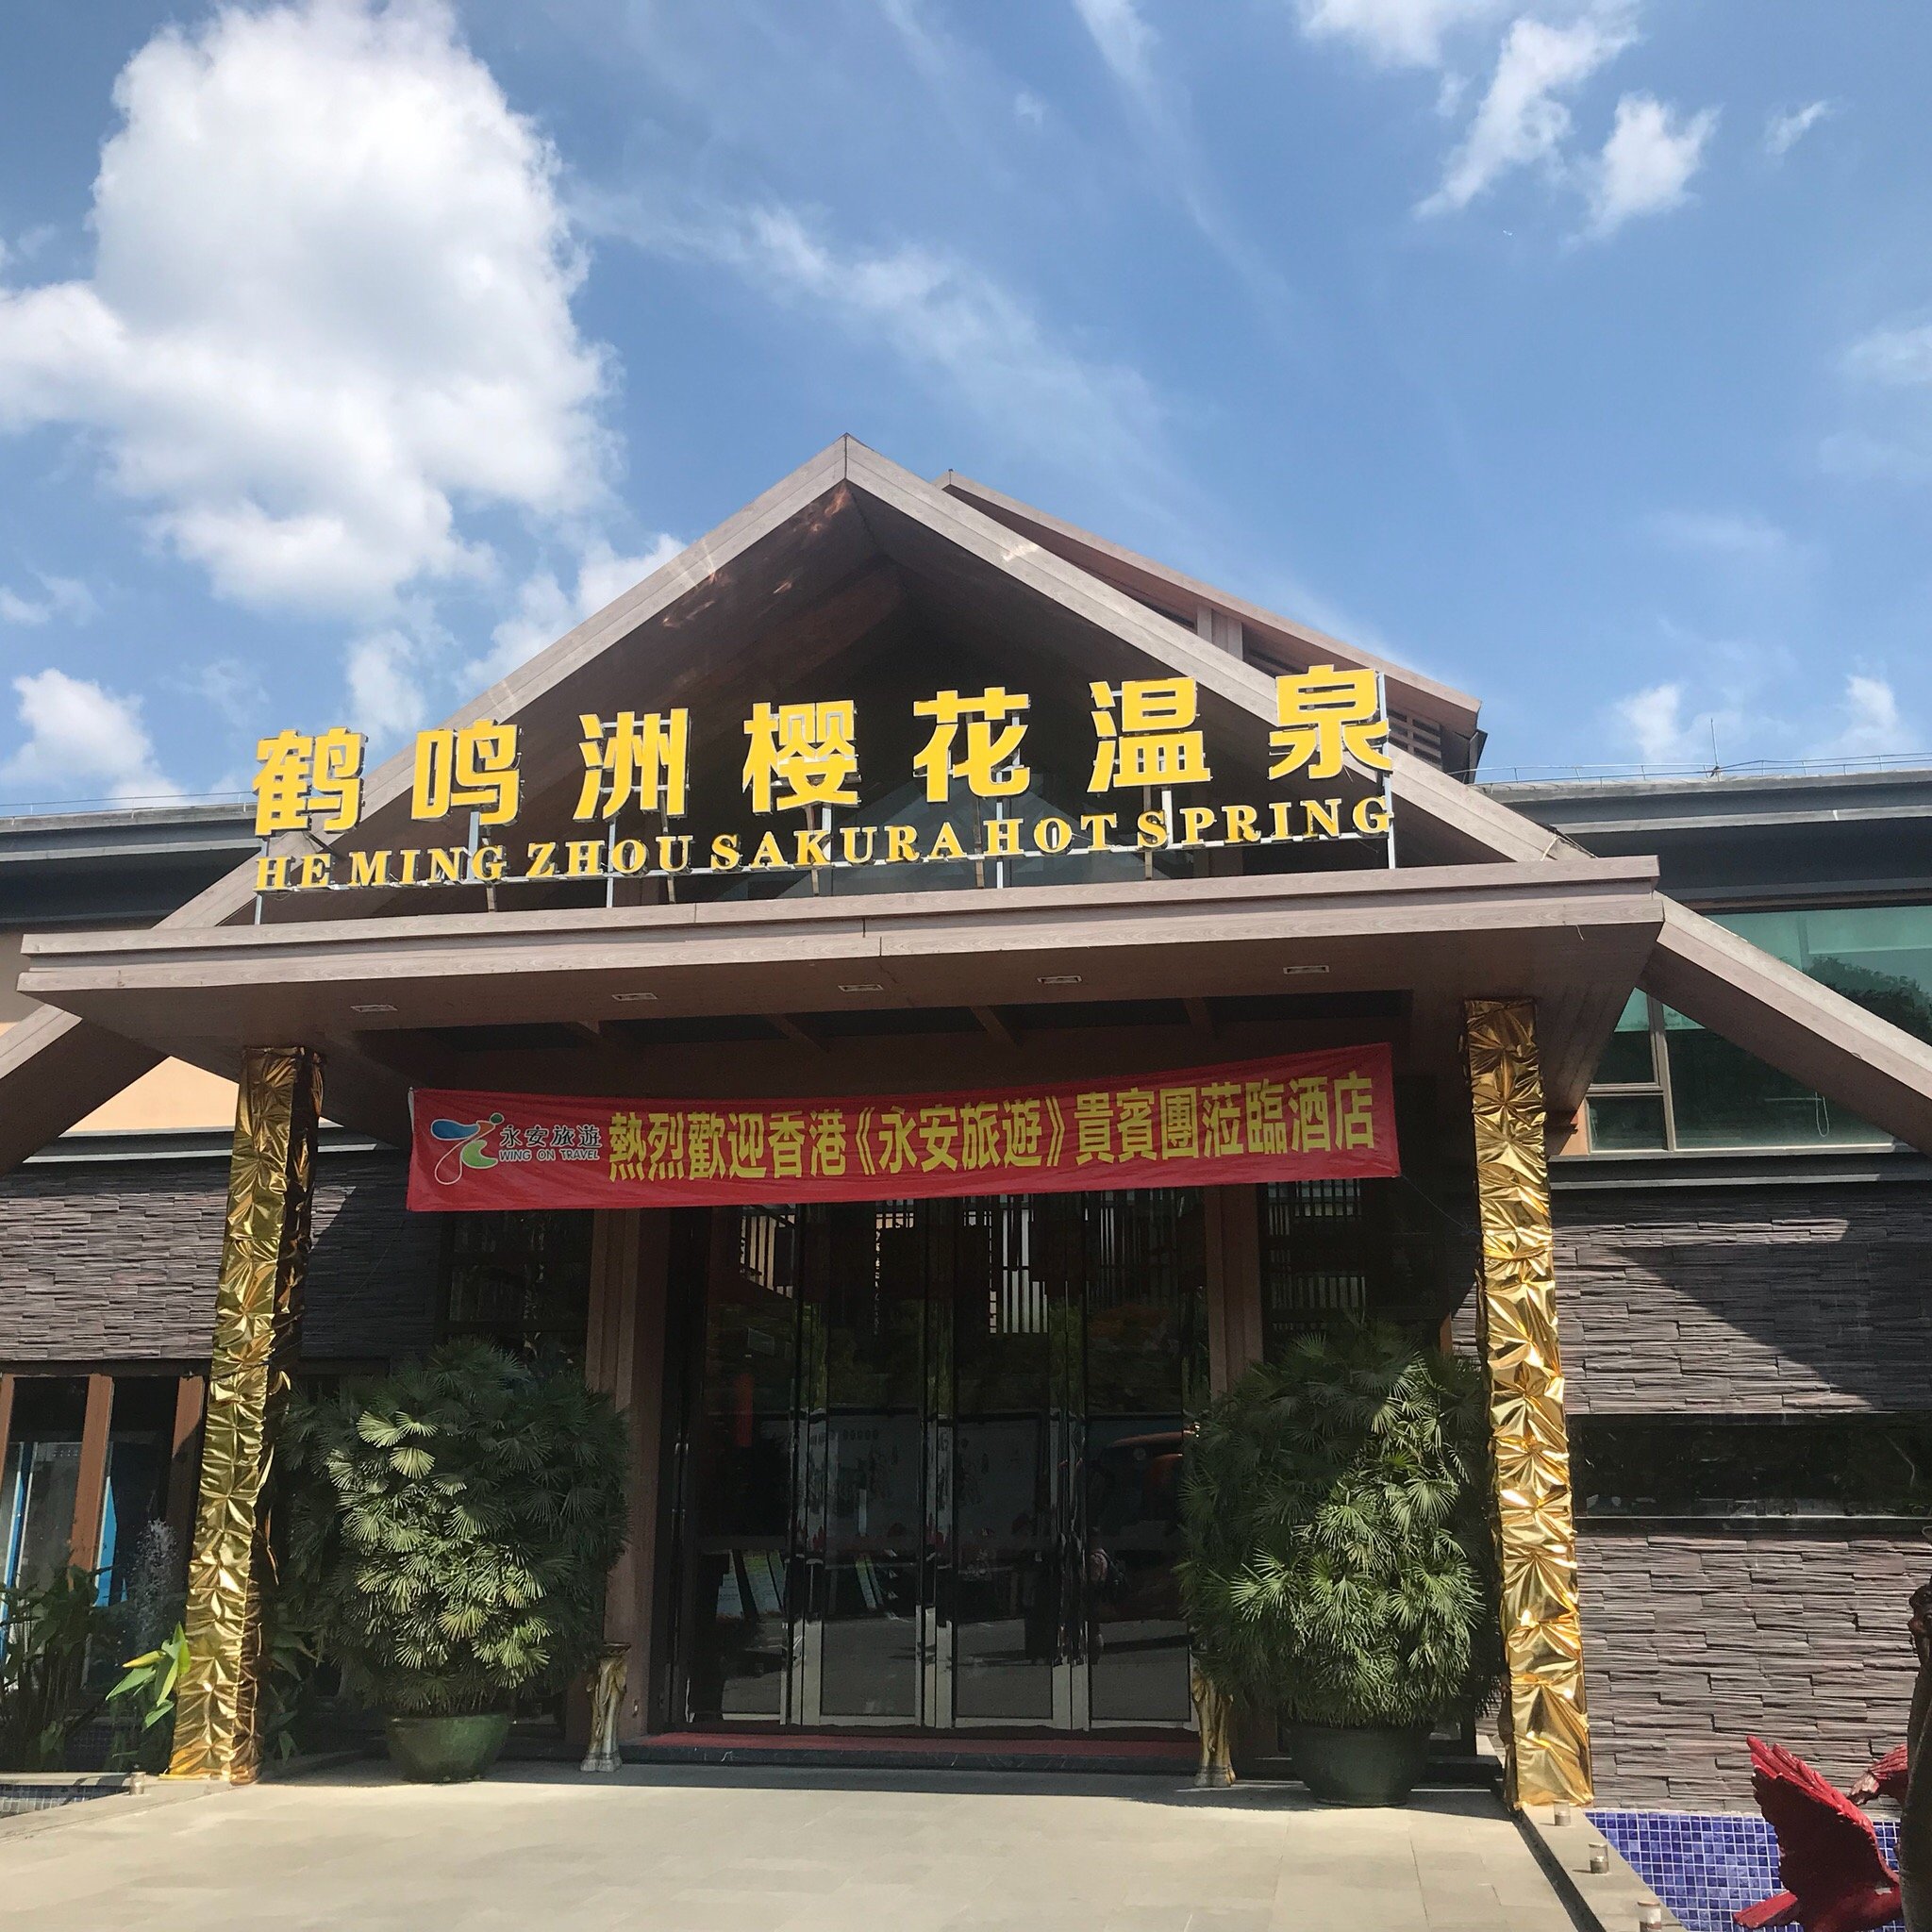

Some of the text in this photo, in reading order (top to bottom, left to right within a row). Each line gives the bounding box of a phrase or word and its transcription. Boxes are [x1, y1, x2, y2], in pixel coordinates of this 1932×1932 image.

[252, 663, 1392, 838] 鹤鸣洲樱花温泉
[253, 795, 1392, 891] HE MING ZHOU SAKURA HOT SPRING
[498, 1147, 601, 1162] WING ON TRAVEL
[499, 1124, 603, 1149] 永安旅遊
